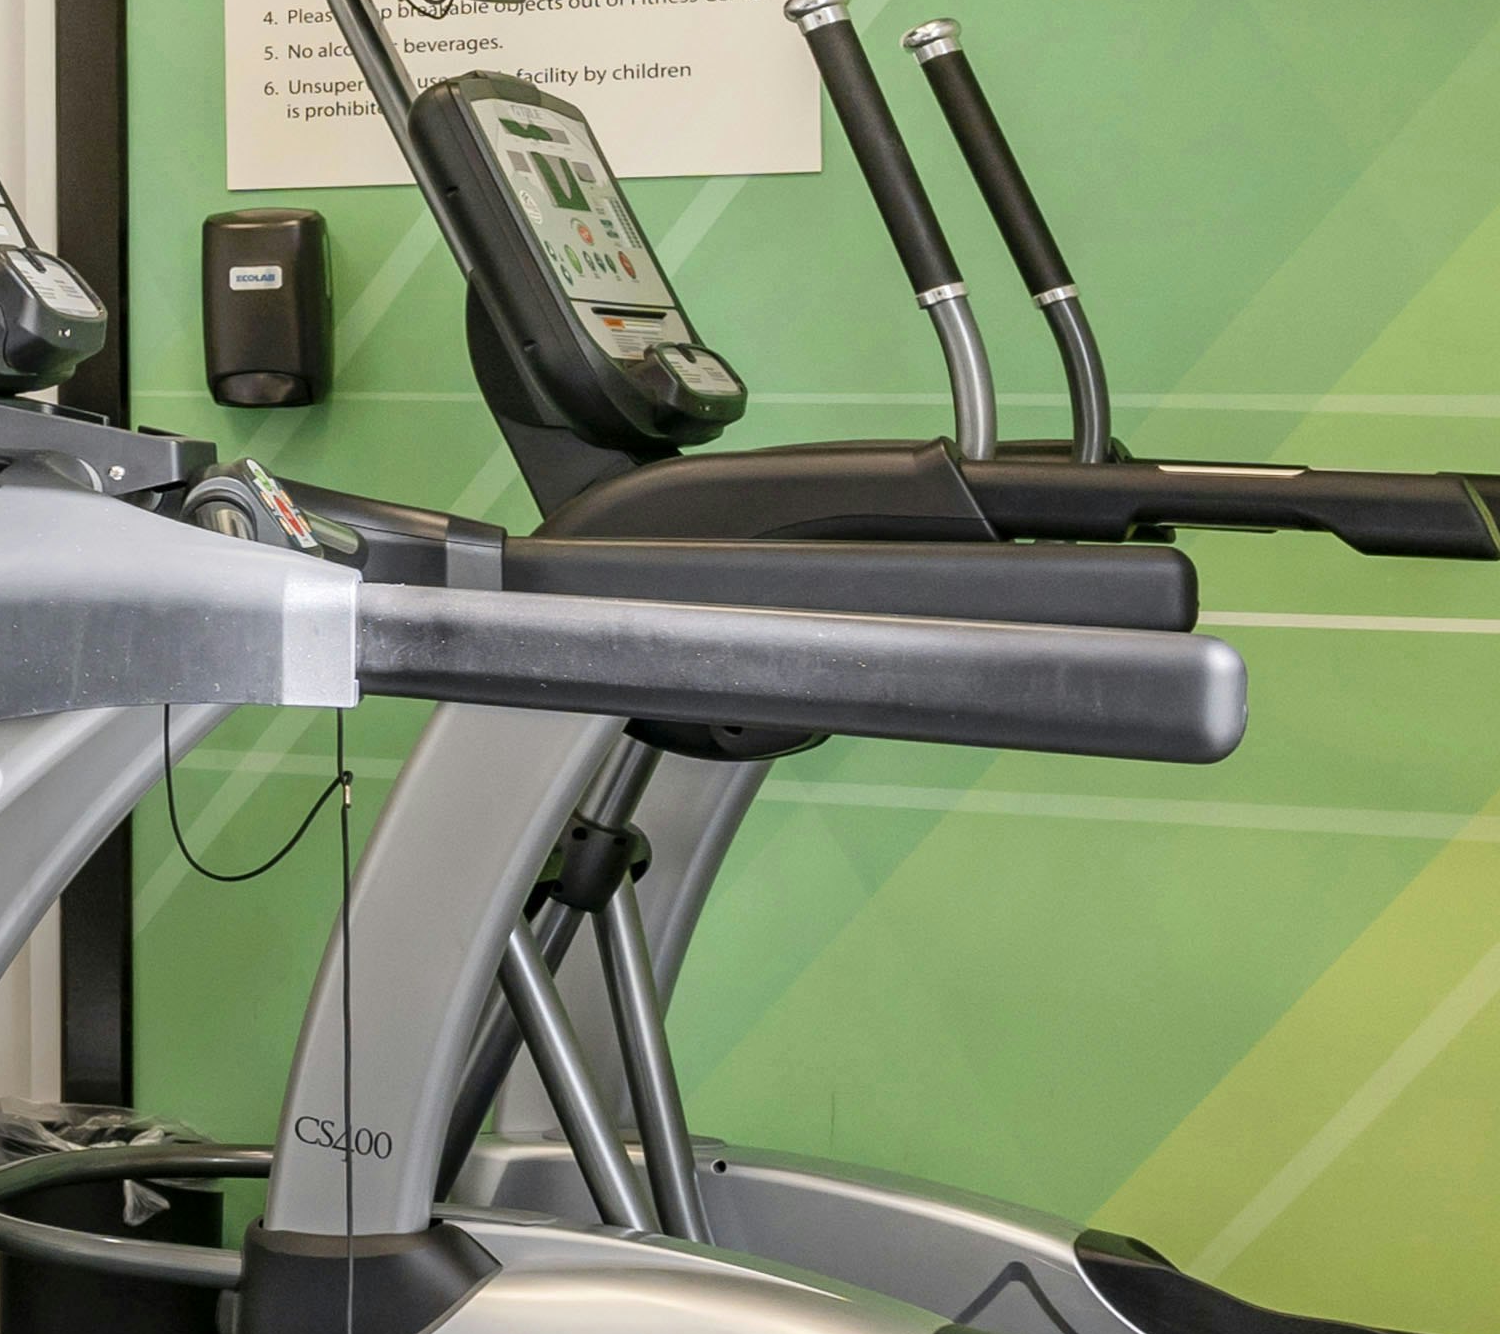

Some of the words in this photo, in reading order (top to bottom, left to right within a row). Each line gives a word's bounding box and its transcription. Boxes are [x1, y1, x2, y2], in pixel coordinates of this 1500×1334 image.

[263, 11, 278, 25] 4.
[288, 8, 333, 24] Pleas
[264, 46, 279, 60] 5.
[288, 44, 313, 59] No
[404, 37, 503, 54] beverages.
[264, 81, 279, 95] 6.
[516, 67, 578, 86] facility
[584, 65, 607, 84] by
[612, 62, 691, 80] children
[287, 104, 300, 118] is
[236, 273, 276, 283] ECOLAB
